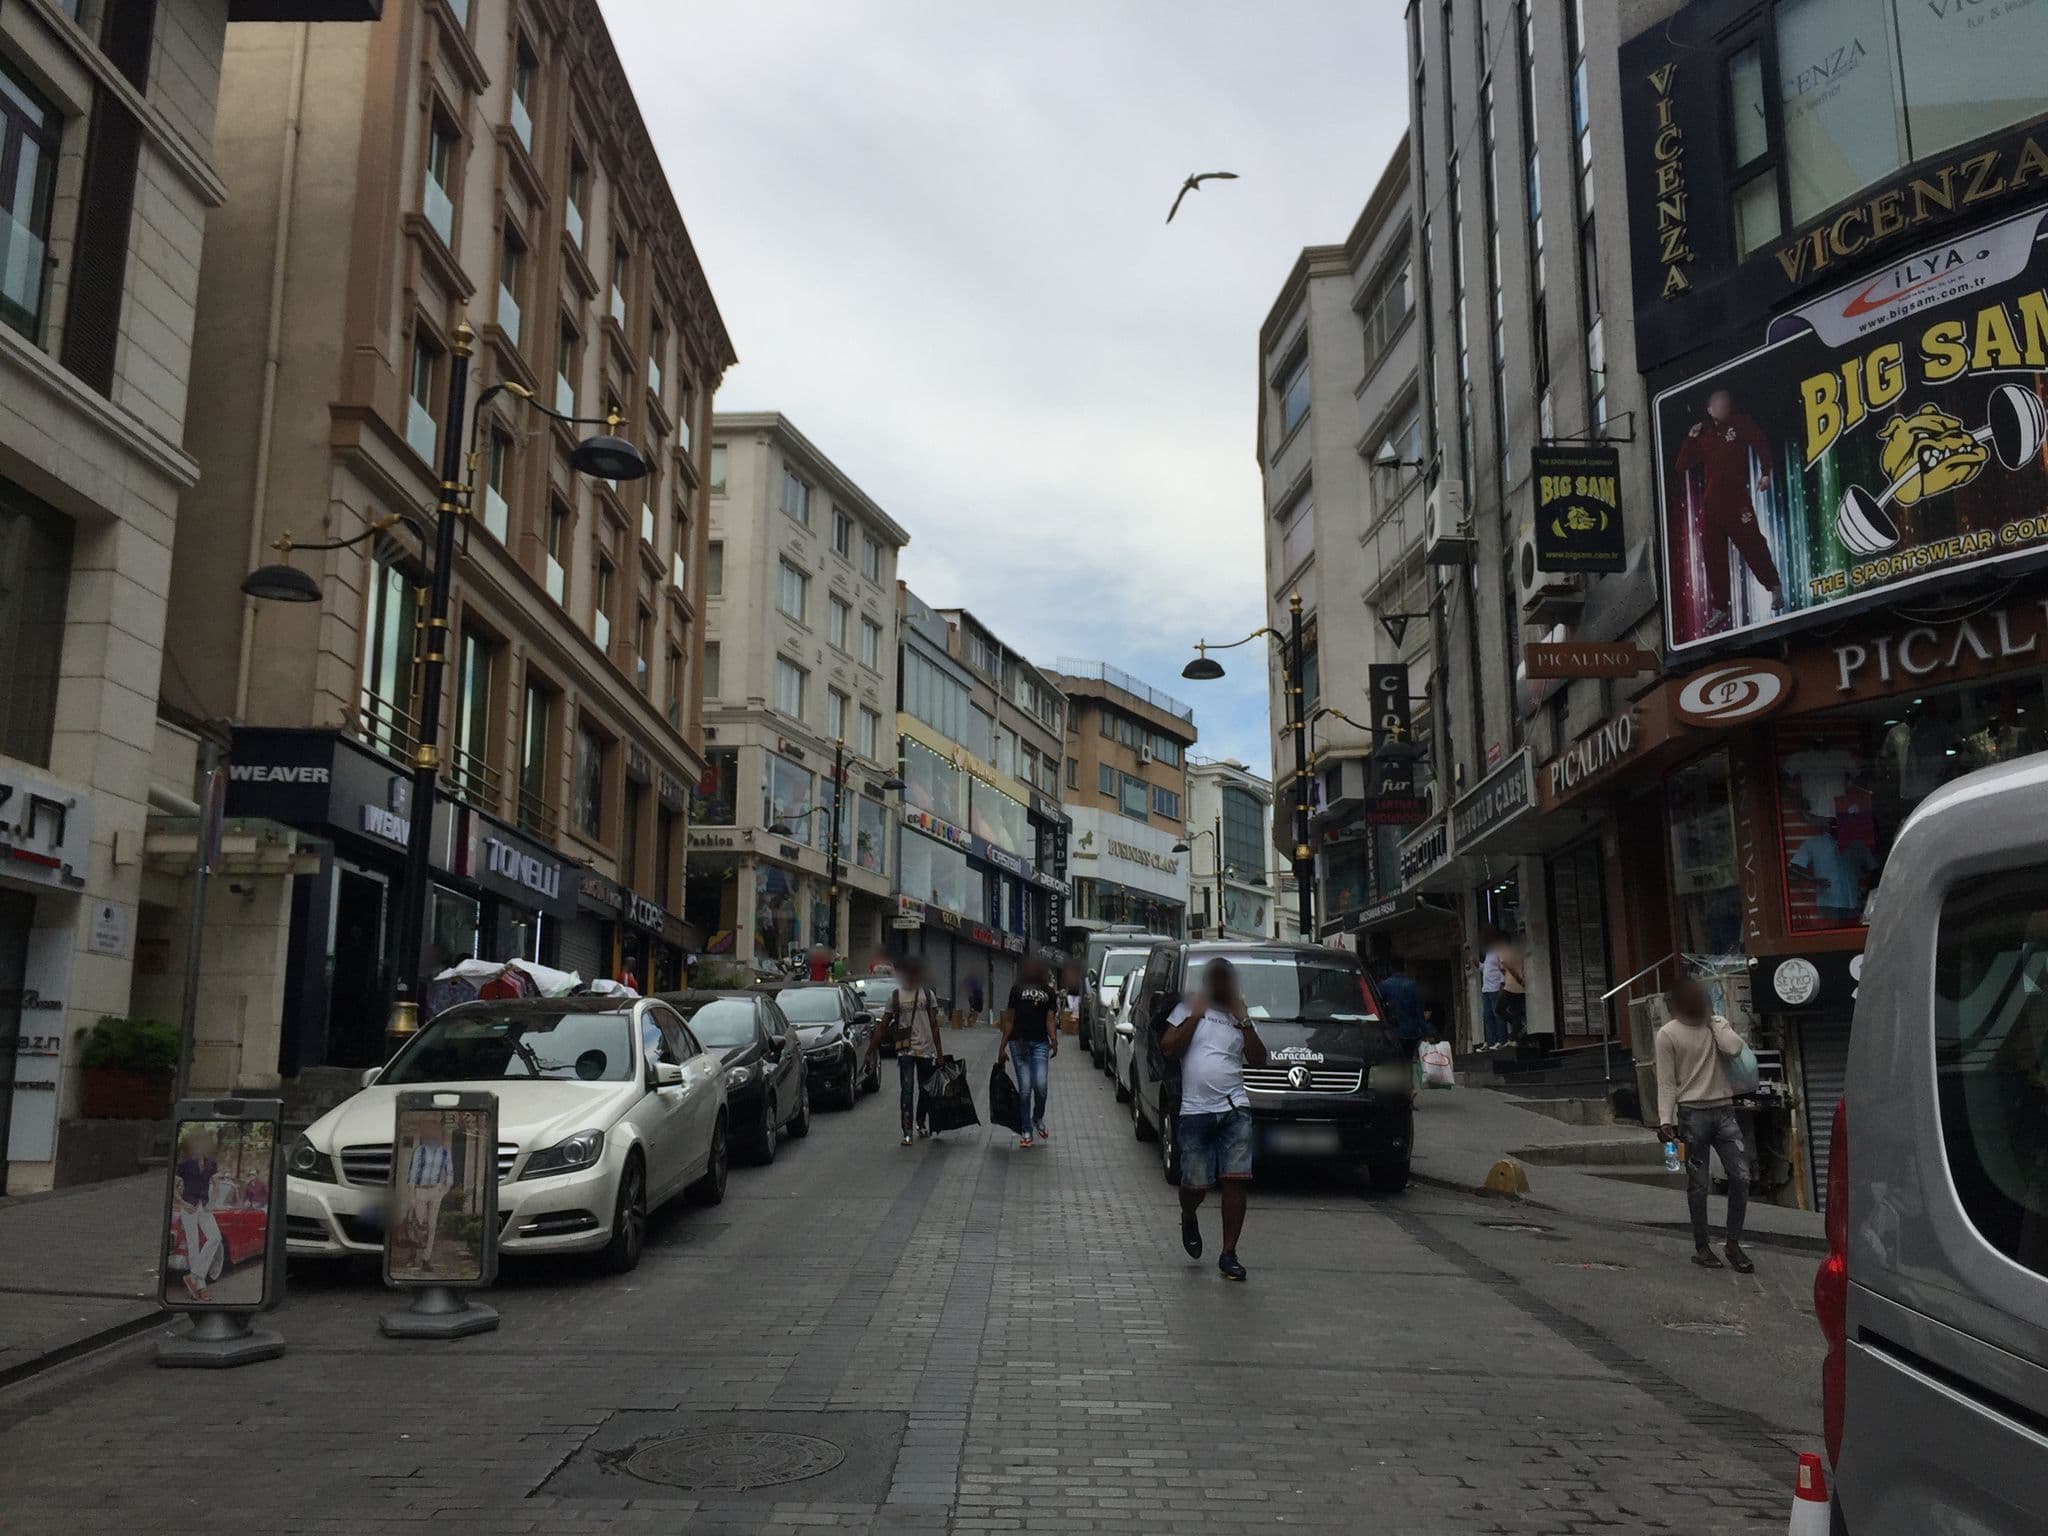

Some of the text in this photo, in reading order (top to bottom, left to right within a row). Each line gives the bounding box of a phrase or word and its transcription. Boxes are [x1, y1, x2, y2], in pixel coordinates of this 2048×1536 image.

[1648, 62, 1692, 297] VICENZA
[1775, 137, 2048, 284] VICENZA
[1858, 276, 1987, 332] www.bigsam.com.tr
[1801, 342, 1905, 470] BIG
[1540, 475, 1617, 509] BIG SAM
[1810, 572, 1847, 597] THE
[1852, 531, 1994, 586] SPORTSWEAR
[1537, 653, 1631, 667] PICALINO
[229, 765, 329, 784] WEAVER
[1551, 714, 1631, 797] PICALINO
